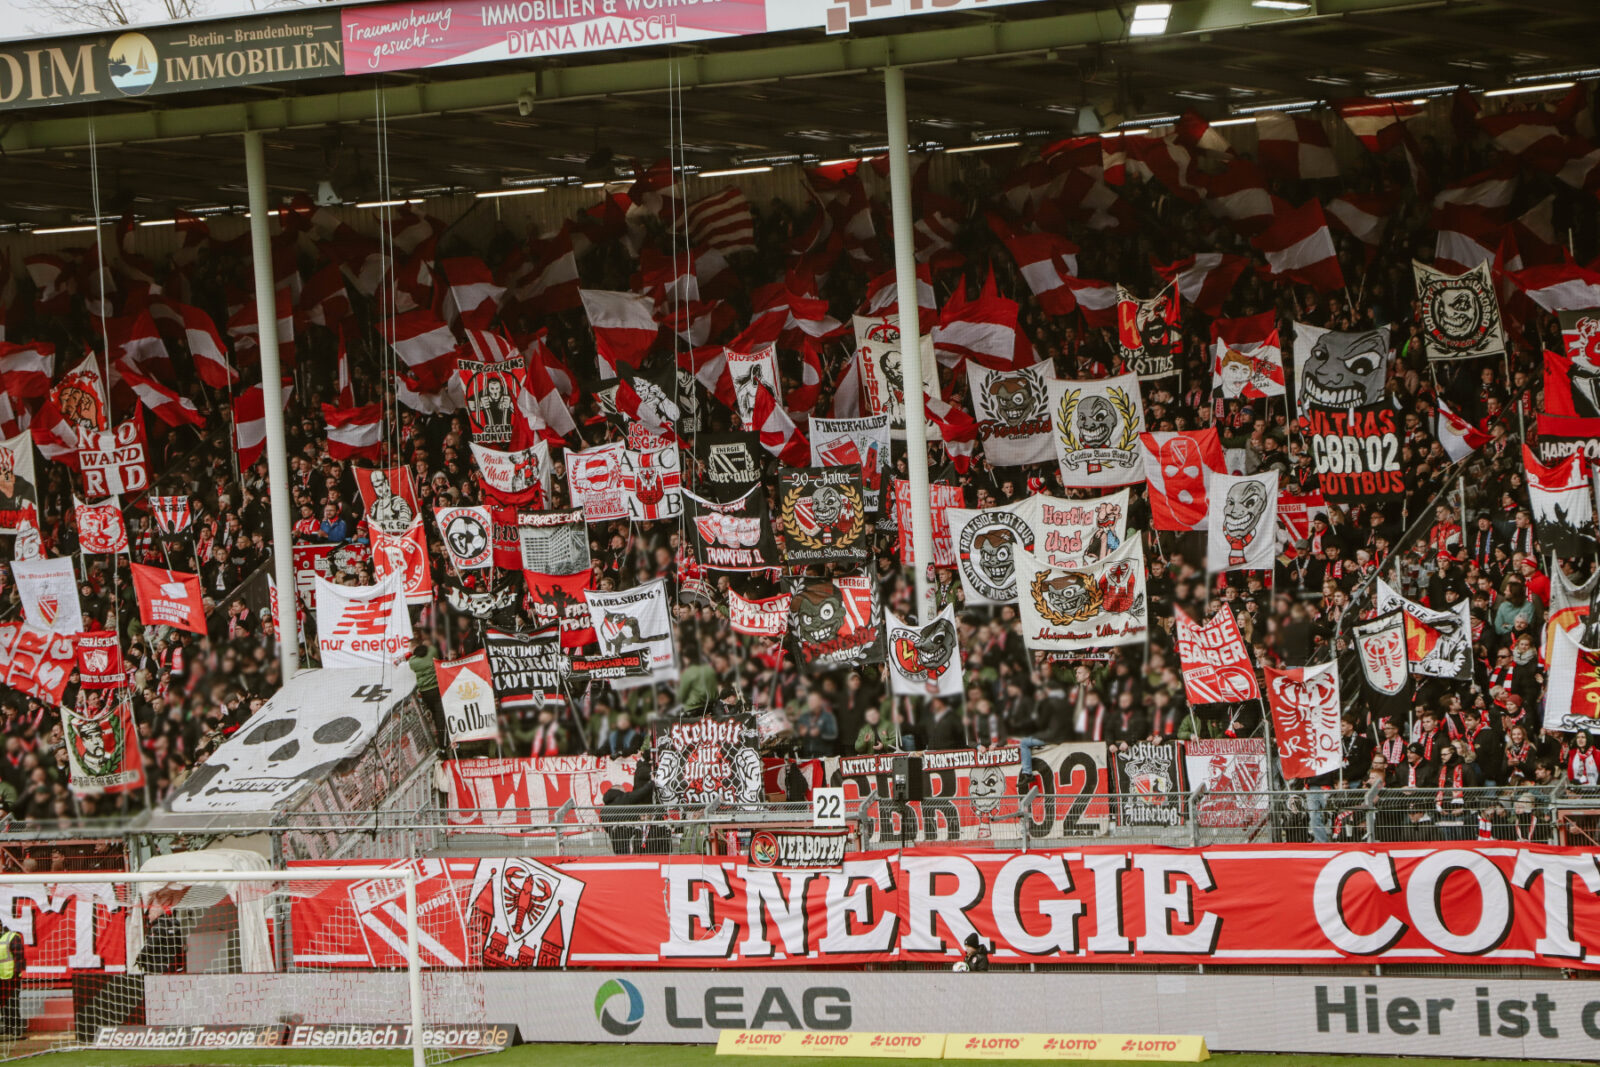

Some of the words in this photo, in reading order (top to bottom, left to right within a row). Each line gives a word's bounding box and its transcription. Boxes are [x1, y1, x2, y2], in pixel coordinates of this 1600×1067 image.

[481, 0, 595, 26] IMMOBILIEN
[346, 7, 452, 44] Traumwohnung
[507, 25, 577, 54] DIANA
[584, 14, 677, 47] MAASCH
[165, 41, 343, 83] IMMOBILIEN
[368, 34, 444, 68] gesucht...
[77, 427, 96, 448] N
[118, 422, 137, 445] O
[1308, 409, 1396, 438] ULTRAS
[81, 447, 141, 467] WAND
[659, 447, 676, 469] C
[86, 471, 107, 496] R
[125, 465, 147, 490] D
[791, 472, 809, 487] 20
[813, 469, 851, 488] Jahre
[1321, 470, 1405, 495] COTTBUS
[664, 493, 682, 515] B
[961, 512, 996, 551] FRONTSIDE
[997, 512, 1034, 545] COTTBUS
[1045, 530, 1082, 555] Und
[839, 578, 866, 588] ENERGIE
[963, 561, 985, 594] AKTIVE
[987, 586, 1018, 600] JUGEN
[590, 592, 655, 607] BABELSBERG
[320, 639, 343, 651] nur
[351, 634, 411, 655] energie
[588, 667, 627, 679] TERROR
[448, 703, 497, 736] Cottbus
[671, 717, 742, 751] Freiheit
[697, 744, 719, 763] für
[924, 751, 975, 770] FRONTSIDE
[977, 747, 1020, 766] COTTBUS
[685, 761, 732, 780] Ultras
[842, 757, 877, 775] AKTIVE
[816, 795, 841, 819] 22
[778, 835, 847, 860] VERBOTEN
[365, 859, 428, 900] ENERIE
[660, 853, 1222, 958] ENERGIE
[665, 985, 853, 1029] LEAG
[1314, 985, 1456, 1036] Hier
[1475, 987, 1559, 1039] ist
[96, 1027, 187, 1047] Eisenbach
[190, 1026, 279, 1047] Tresore.de
[291, 1026, 402, 1046] Eisenbach
[403, 1026, 507, 1047] Tesore.de
[748, 1034, 782, 1045] LOTTO
[812, 1035, 849, 1046] LOTTO
[884, 1035, 922, 1047] LOTTO
[981, 1038, 1020, 1049] LOTTO
[1059, 1038, 1097, 1051] LOTTO
[1137, 1039, 1177, 1052] LOTTO
